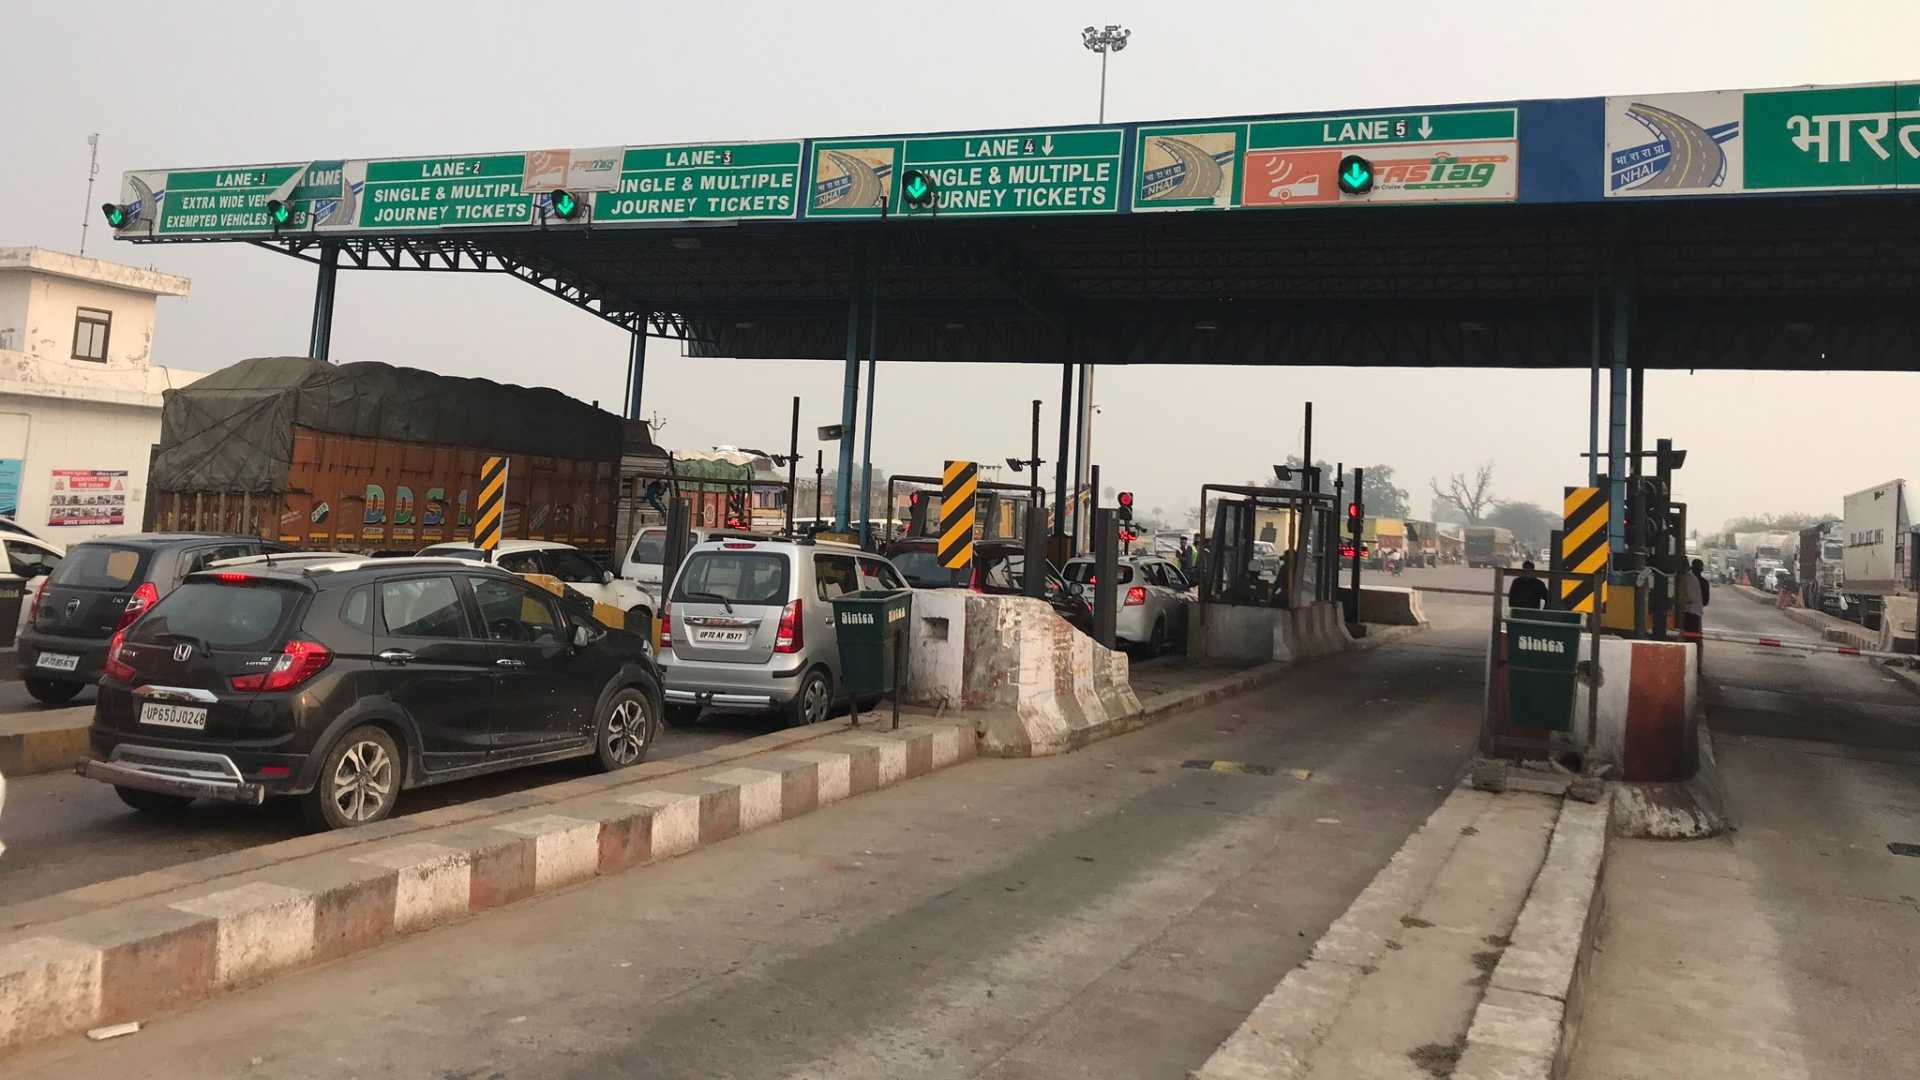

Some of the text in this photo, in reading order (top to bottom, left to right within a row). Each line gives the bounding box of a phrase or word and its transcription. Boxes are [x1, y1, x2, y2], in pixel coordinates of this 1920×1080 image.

[1323, 120, 1406, 142] LANE 5
[964, 139, 1034, 158] LANE 4
[309, 170, 342, 186] LANE
[914, 163, 1110, 187] NGLE & MULTIPLE
[1620, 162, 1655, 184] NHAI
[608, 173, 793, 194] INGLE & MULTIPLE
[182, 197, 217, 209] EXTRA
[219, 195, 245, 208] WIDE
[374, 184, 530, 203] SINGLE & MULTIPL
[1013, 186, 1106, 207] TICKETS
[374, 206, 449, 222] JOURNEY
[455, 203, 527, 219] TICKETS
[611, 195, 790, 215] JOURNEY TICKETS
[166, 214, 217, 228] EXEMPTED
[220, 212, 268, 226] VEHICLES
